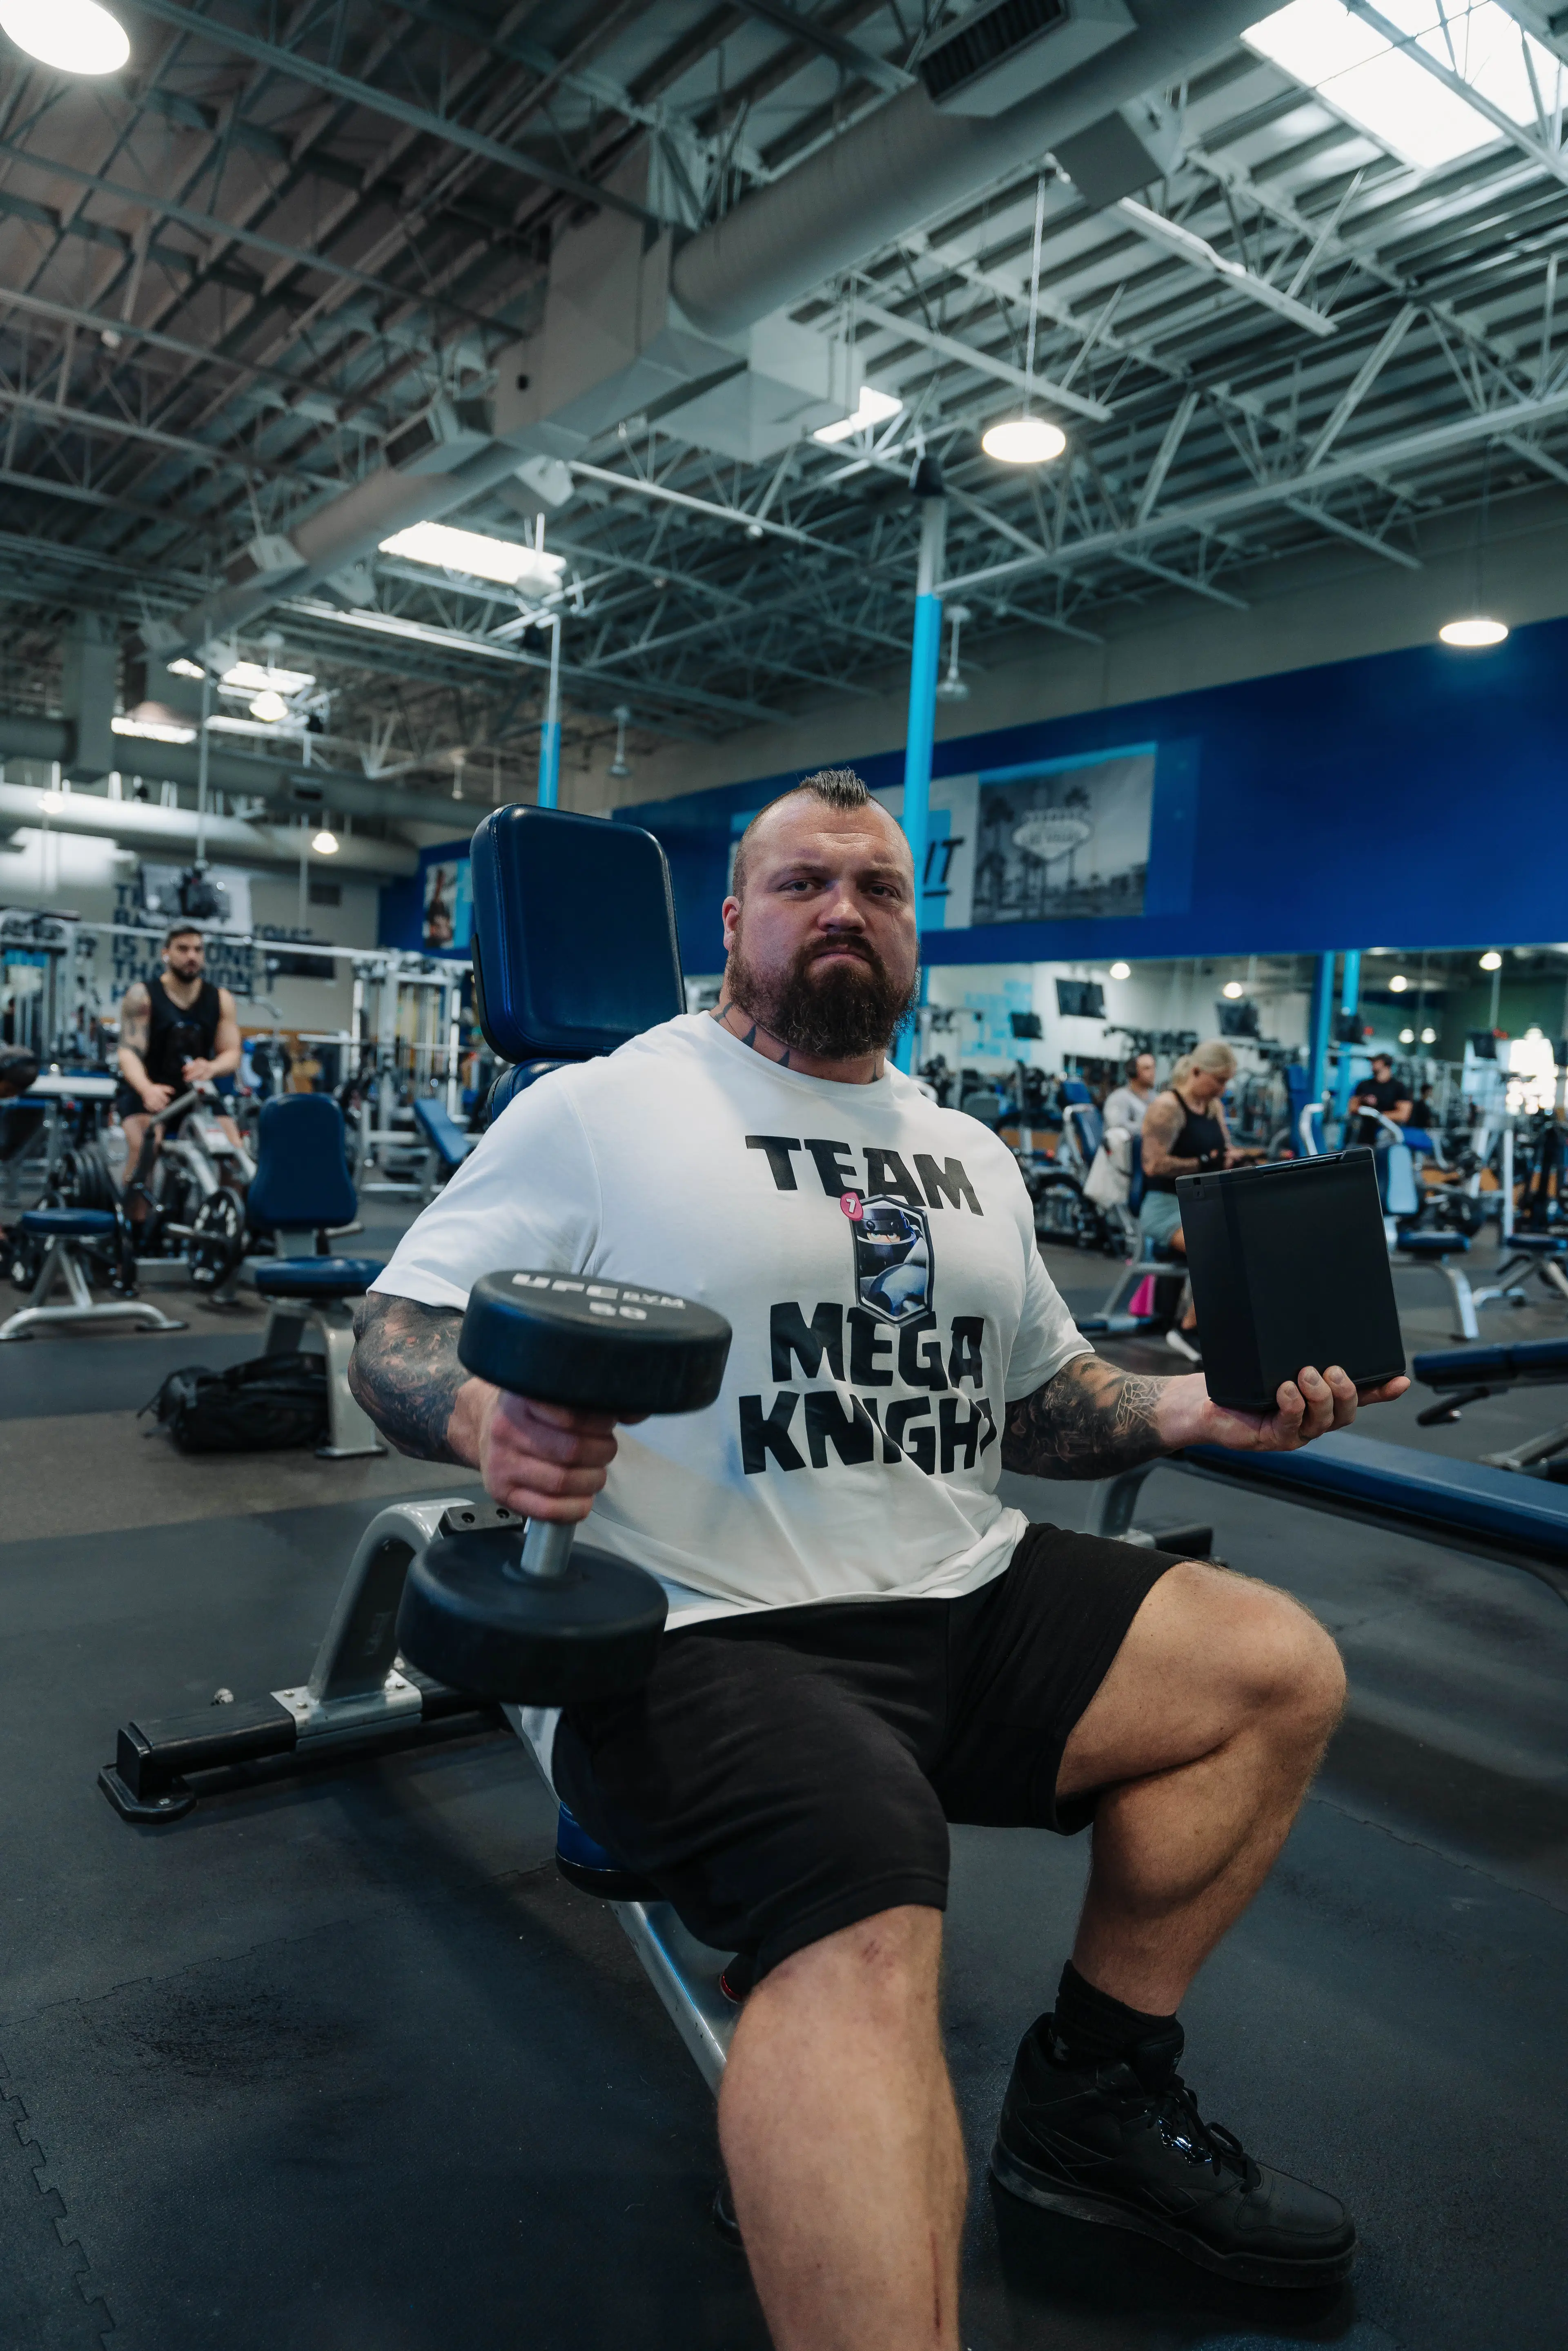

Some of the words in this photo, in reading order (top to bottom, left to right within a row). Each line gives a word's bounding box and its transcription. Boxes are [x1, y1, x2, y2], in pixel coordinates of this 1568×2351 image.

[745, 1135, 984, 1216] TEAM
[845, 1198, 856, 1213] 7
[770, 1301, 984, 1392] MEGA
